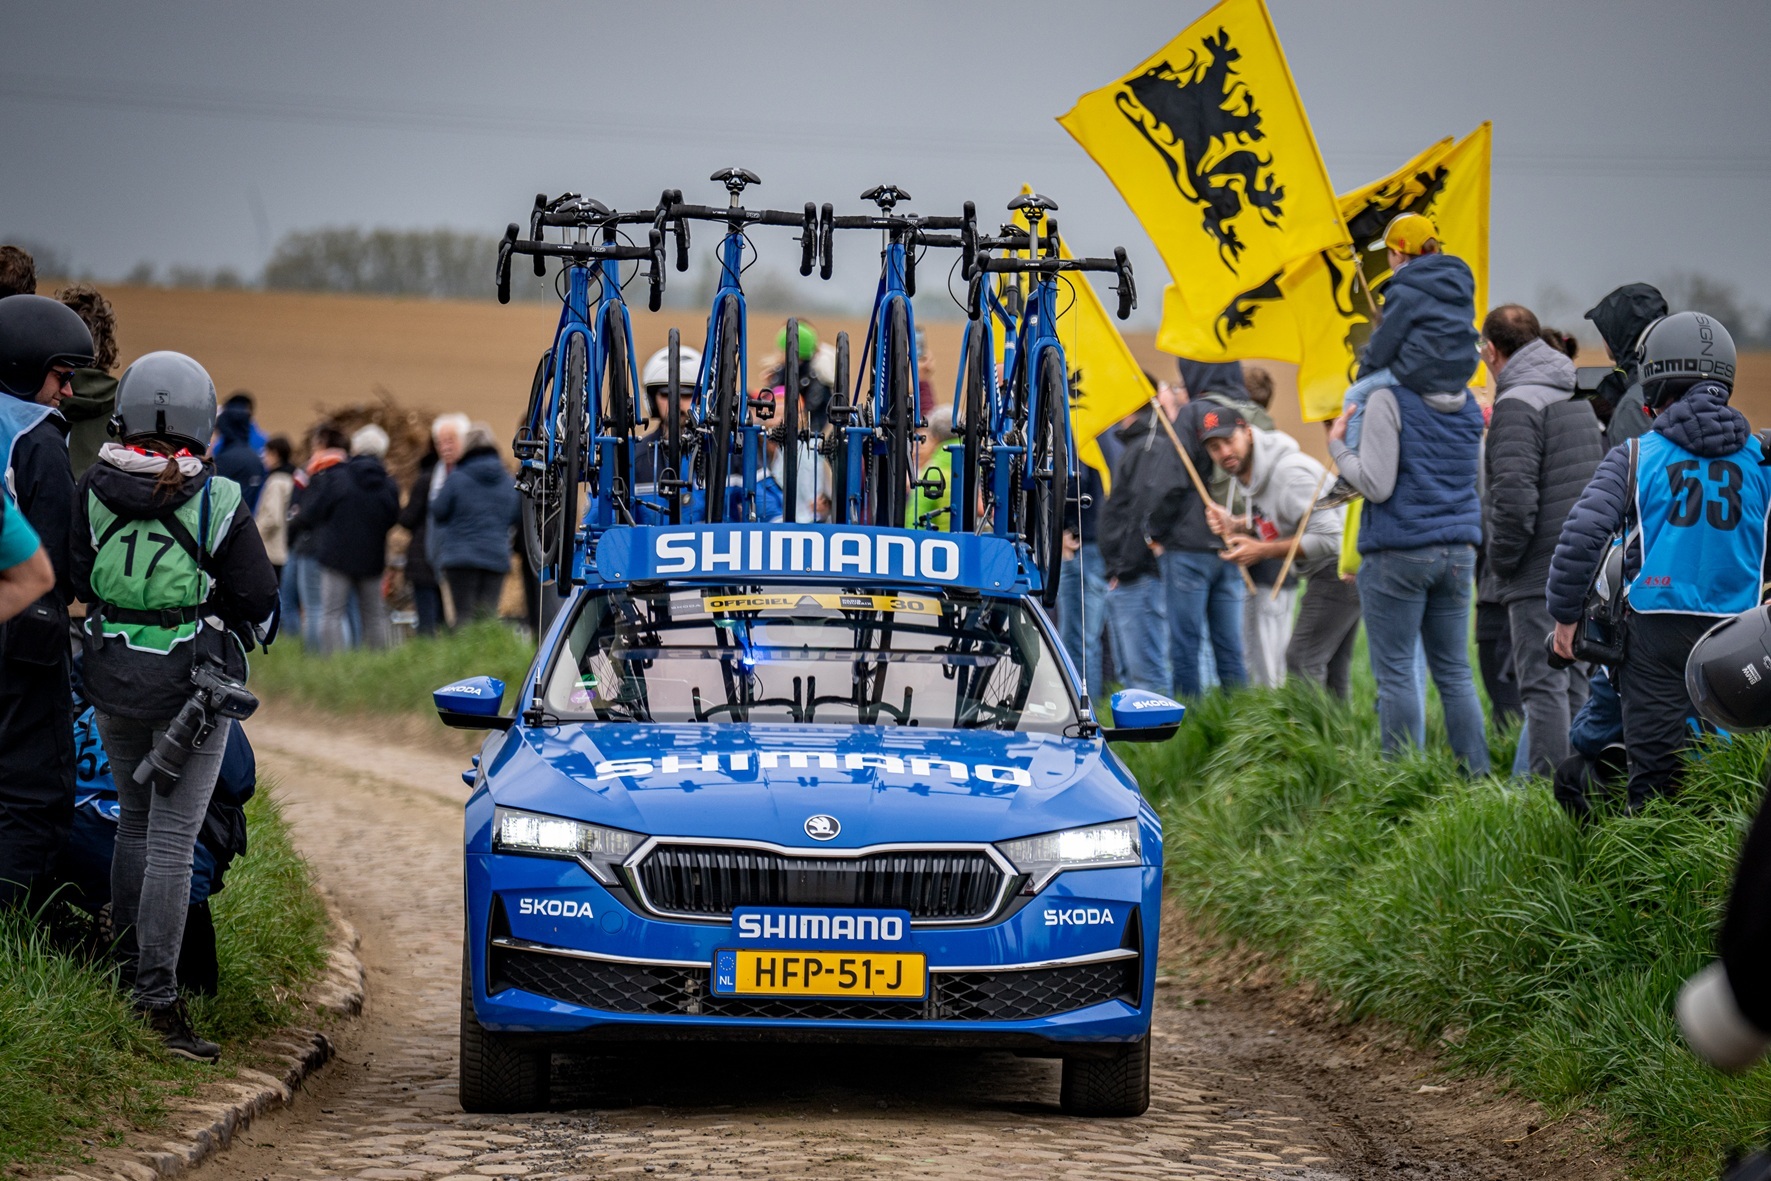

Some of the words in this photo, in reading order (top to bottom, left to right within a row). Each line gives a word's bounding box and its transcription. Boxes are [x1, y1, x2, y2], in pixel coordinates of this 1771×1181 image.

[1665, 459, 1743, 531] 53
[120, 529, 175, 580] 17
[655, 530, 960, 580] SHIMANO
[710, 597, 793, 608] OFFICIEL
[889, 599, 925, 611] 30
[1741, 667, 1758, 686] BMW
[595, 751, 1032, 787] SHIMANO
[738, 914, 903, 941] SHIMANO
[719, 975, 734, 986] NL
[755, 957, 902, 990] HFP-51-J
